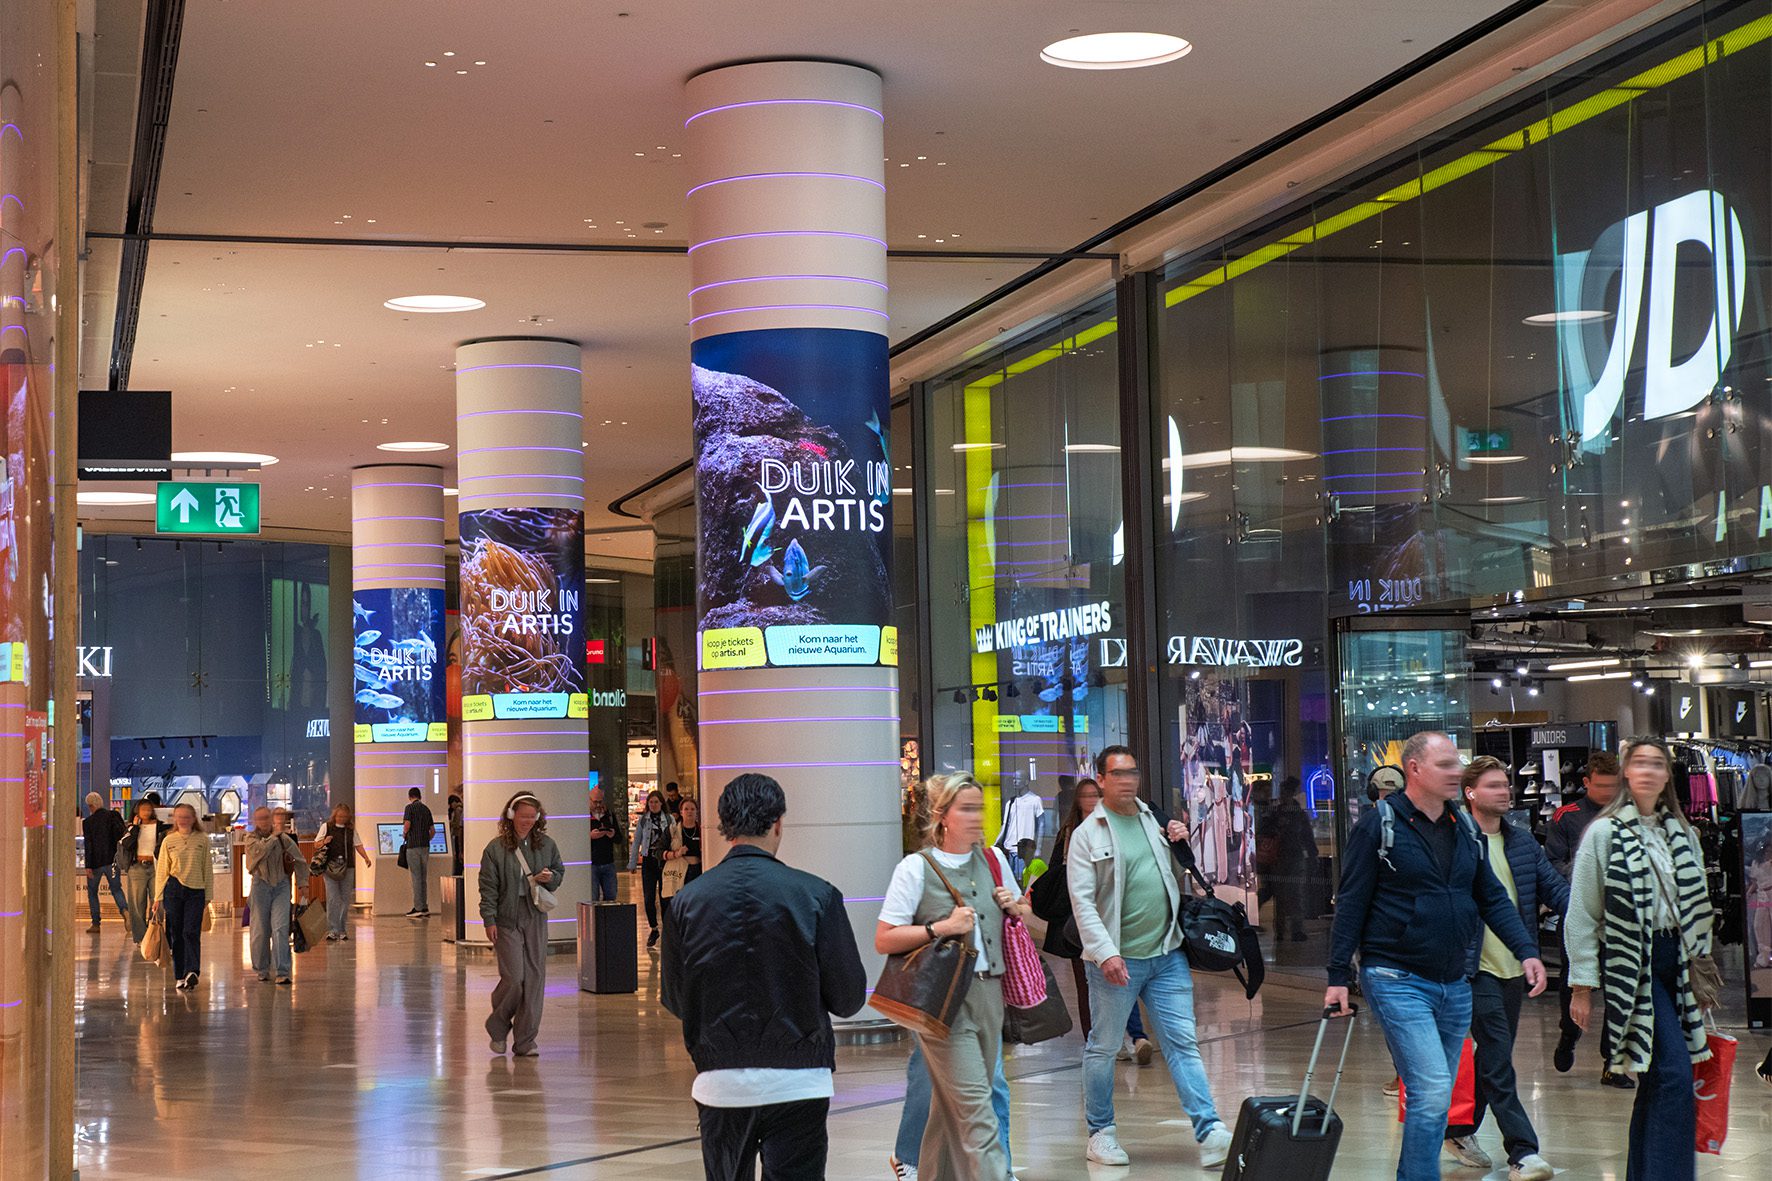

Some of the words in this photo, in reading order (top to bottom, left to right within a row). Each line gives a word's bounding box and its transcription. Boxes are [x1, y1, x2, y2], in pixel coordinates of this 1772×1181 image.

[1582, 189, 1746, 443] JD
[761, 458, 856, 495] DUIK
[867, 460, 889, 496] IN
[780, 497, 885, 532] ARTIS
[490, 589, 552, 612] DUIK
[559, 589, 579, 612] IN
[502, 613, 574, 635] ARTIS
[995, 617, 1027, 650] KING
[1026, 614, 1040, 638] OF
[1039, 601, 1112, 642] TRAINERS
[728, 638, 754, 646] tickets
[799, 634, 821, 644] Kom
[822, 636, 842, 644] naar
[844, 634, 858, 644] het
[370, 647, 415, 665] DUIK
[420, 647, 438, 664] IN
[719, 648, 746, 657] artis.nl
[788, 646, 822, 654] nieuwe
[823, 644, 867, 655] Aquarium.
[75, 646, 113, 677] KI
[378, 665, 433, 681] ARTIS
[1531, 730, 1567, 745] JUNIORS
